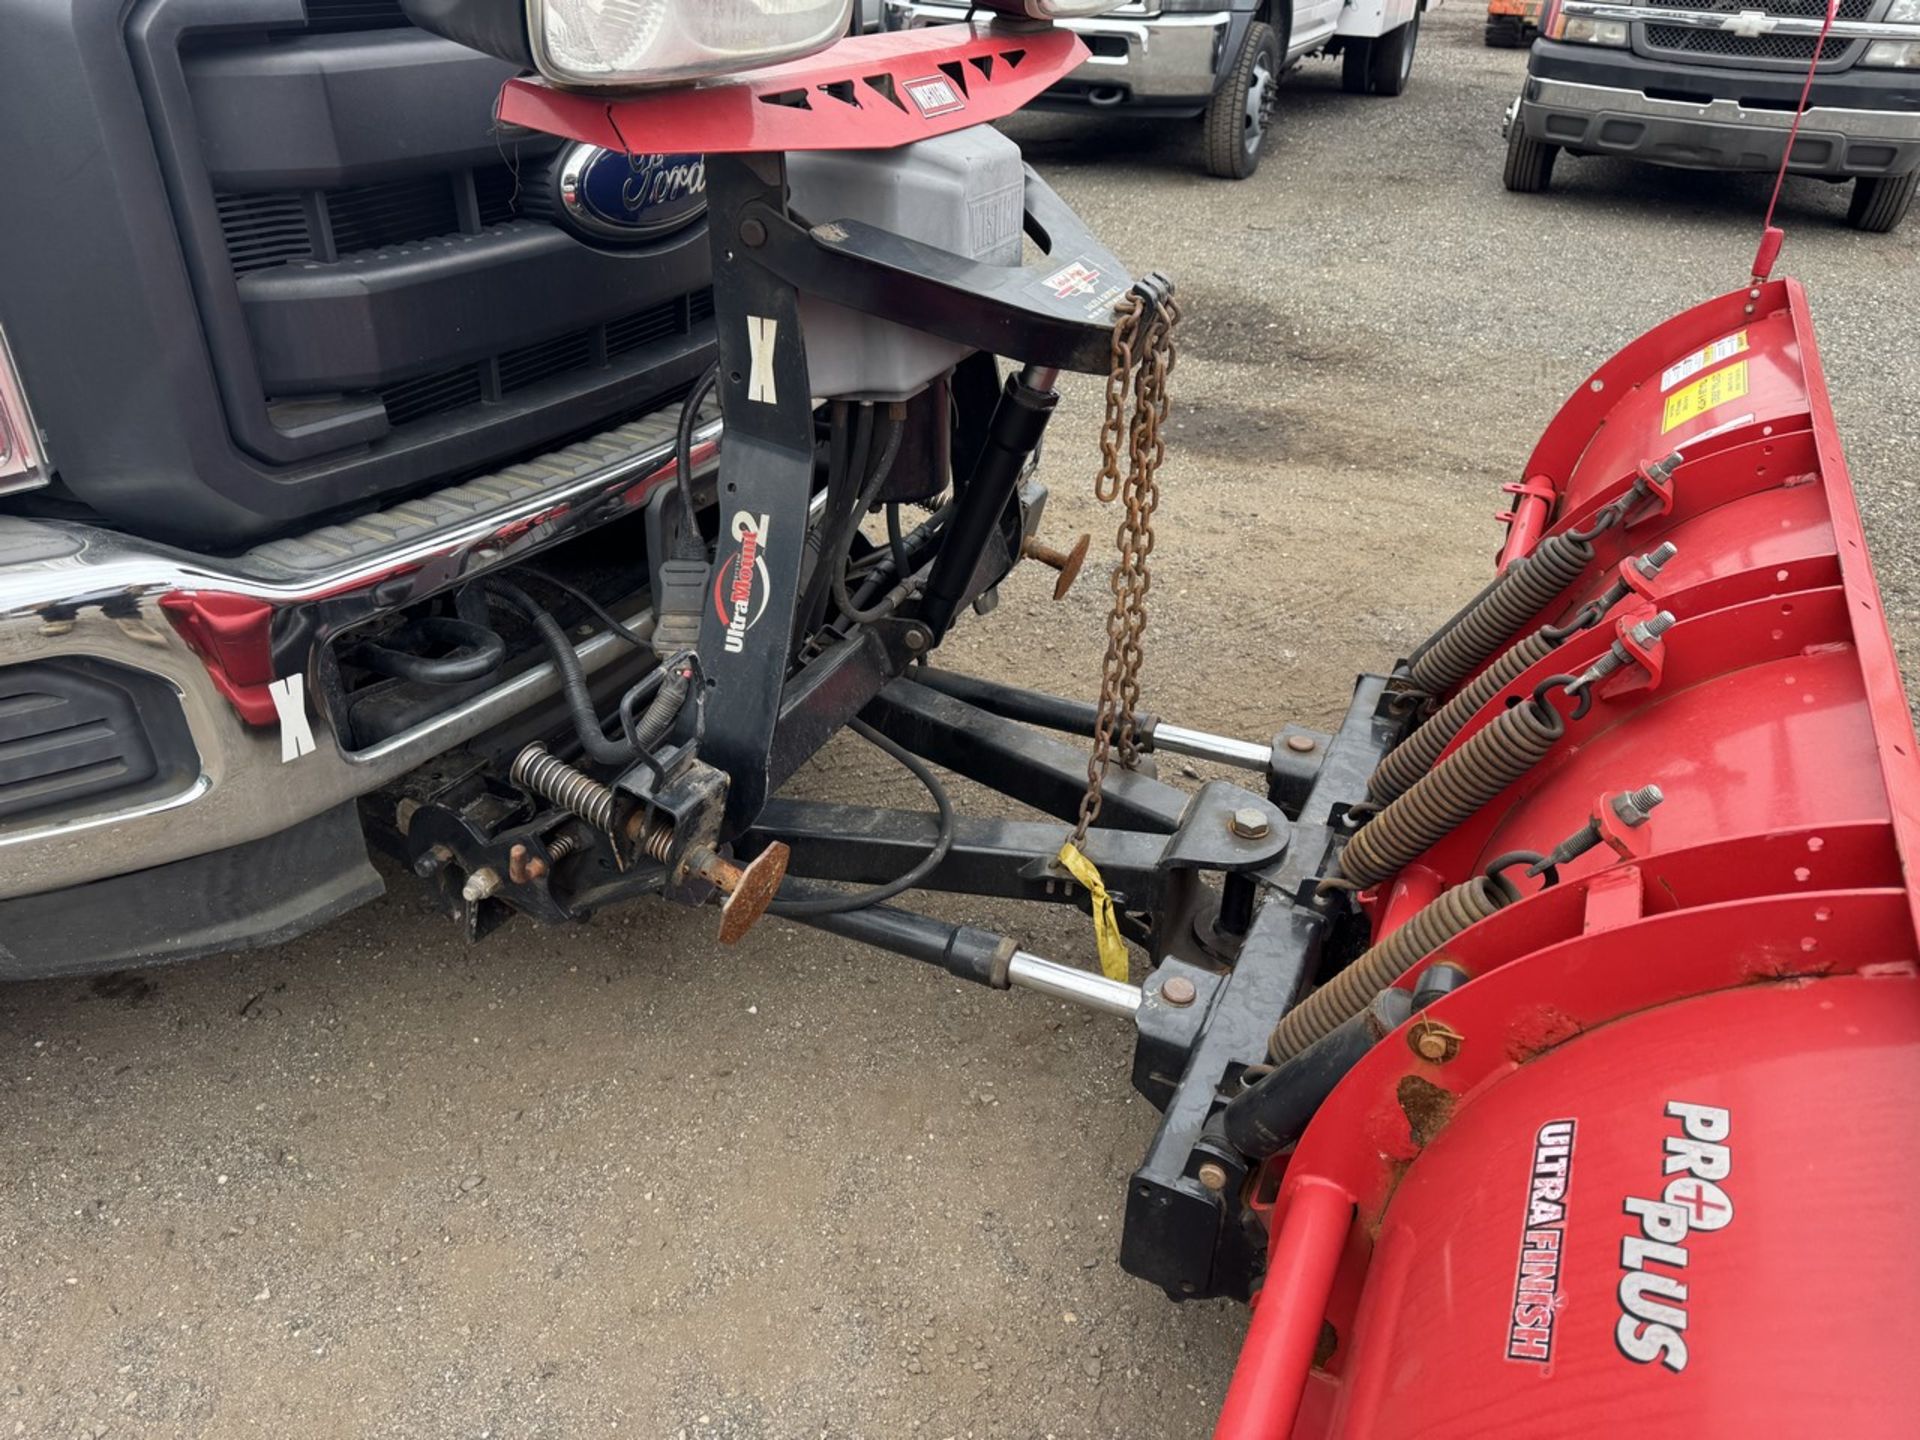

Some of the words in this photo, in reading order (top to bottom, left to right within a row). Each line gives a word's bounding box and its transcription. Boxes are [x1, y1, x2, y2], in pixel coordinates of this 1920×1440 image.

[623, 153, 706, 211] Ford
[731, 510, 770, 548] 2
[724, 530, 757, 653] UltraMount
[1526, 1120, 1574, 1227] ULTRA
[1663, 1101, 1734, 1231] PRO
[1509, 1229, 1563, 1361] FINISH
[1615, 1196, 1689, 1373] PLUS
